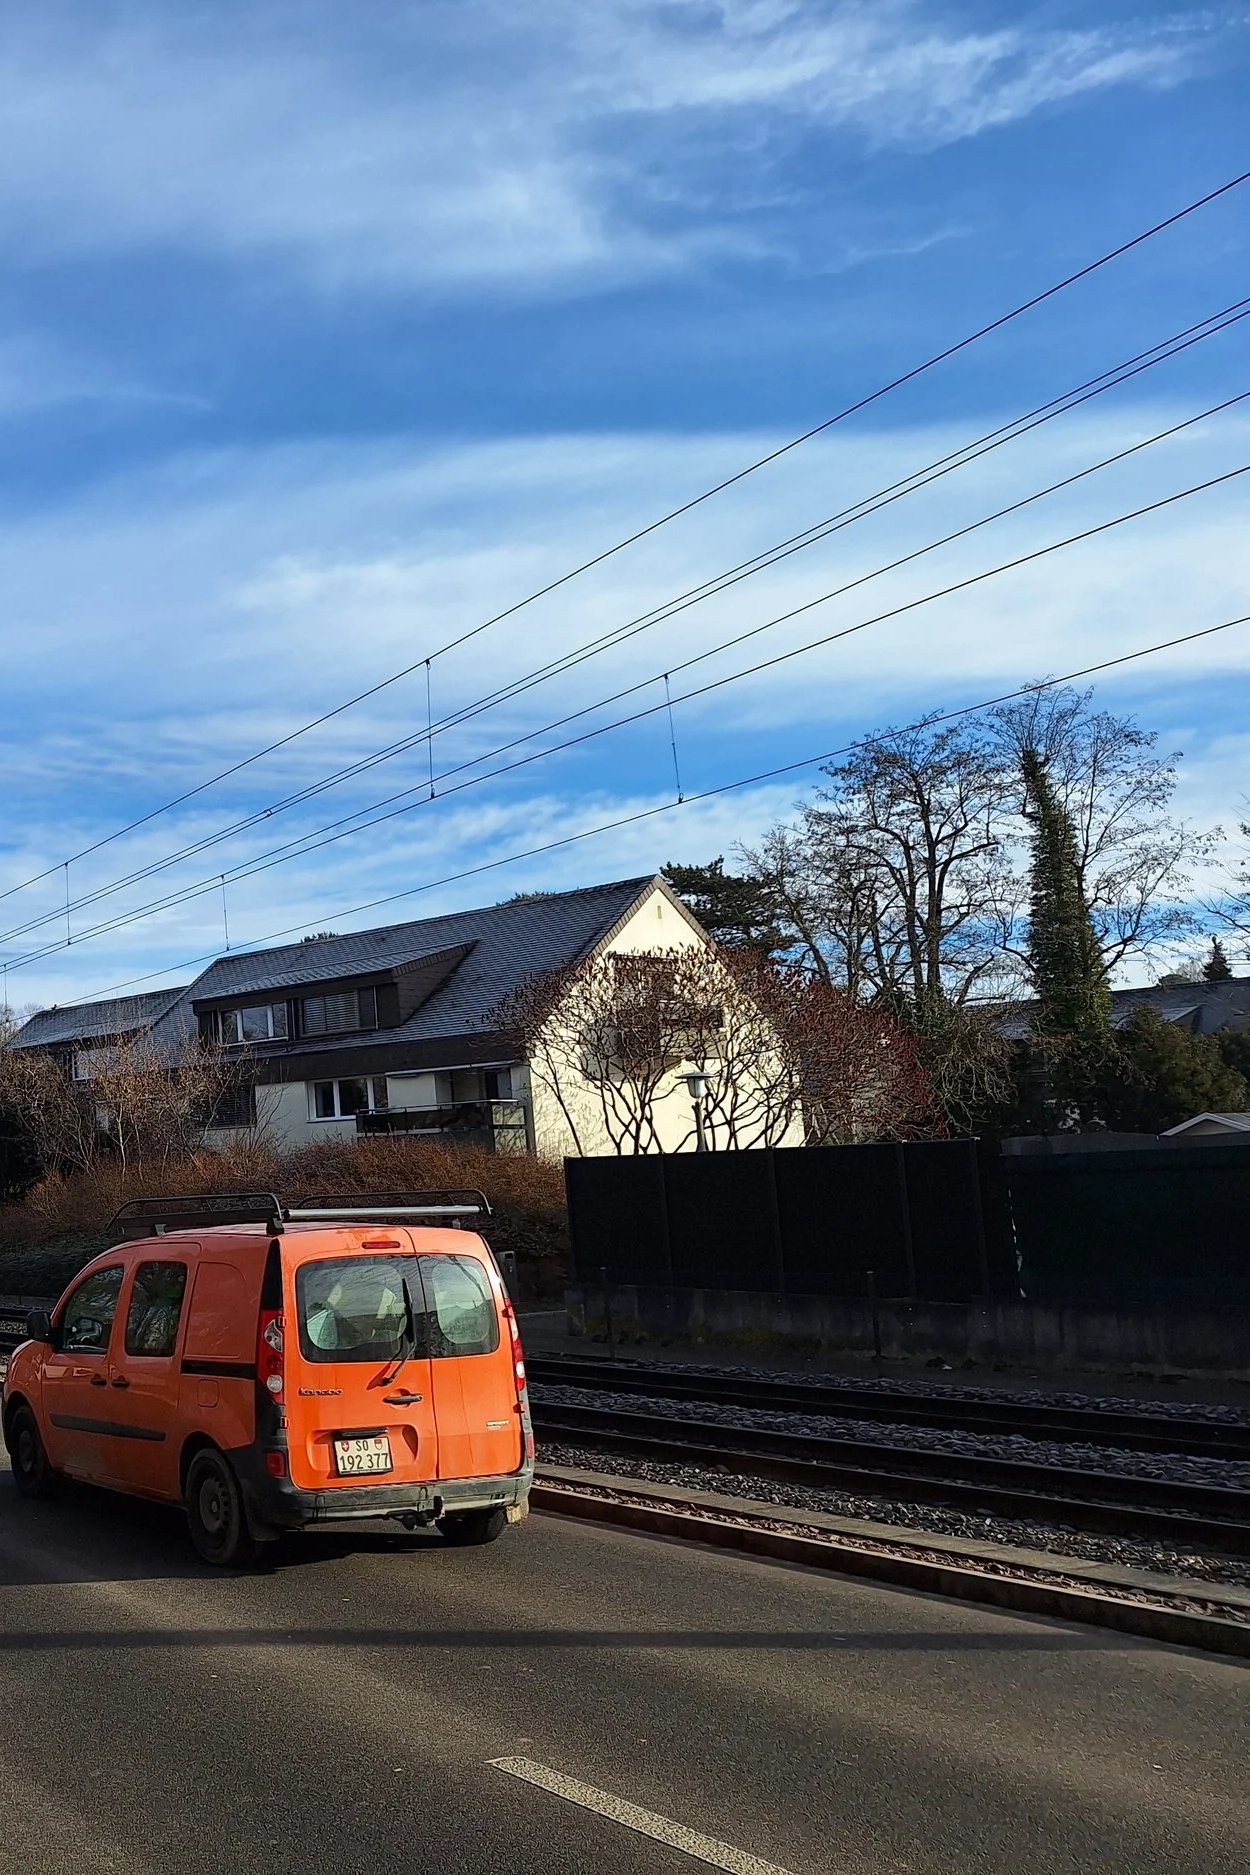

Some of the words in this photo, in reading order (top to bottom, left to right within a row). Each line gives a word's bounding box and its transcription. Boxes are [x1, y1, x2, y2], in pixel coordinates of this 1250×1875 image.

[355, 1440, 369, 1451] SO
[339, 1454, 363, 1470] 192
[366, 1452, 389, 1469] 377
